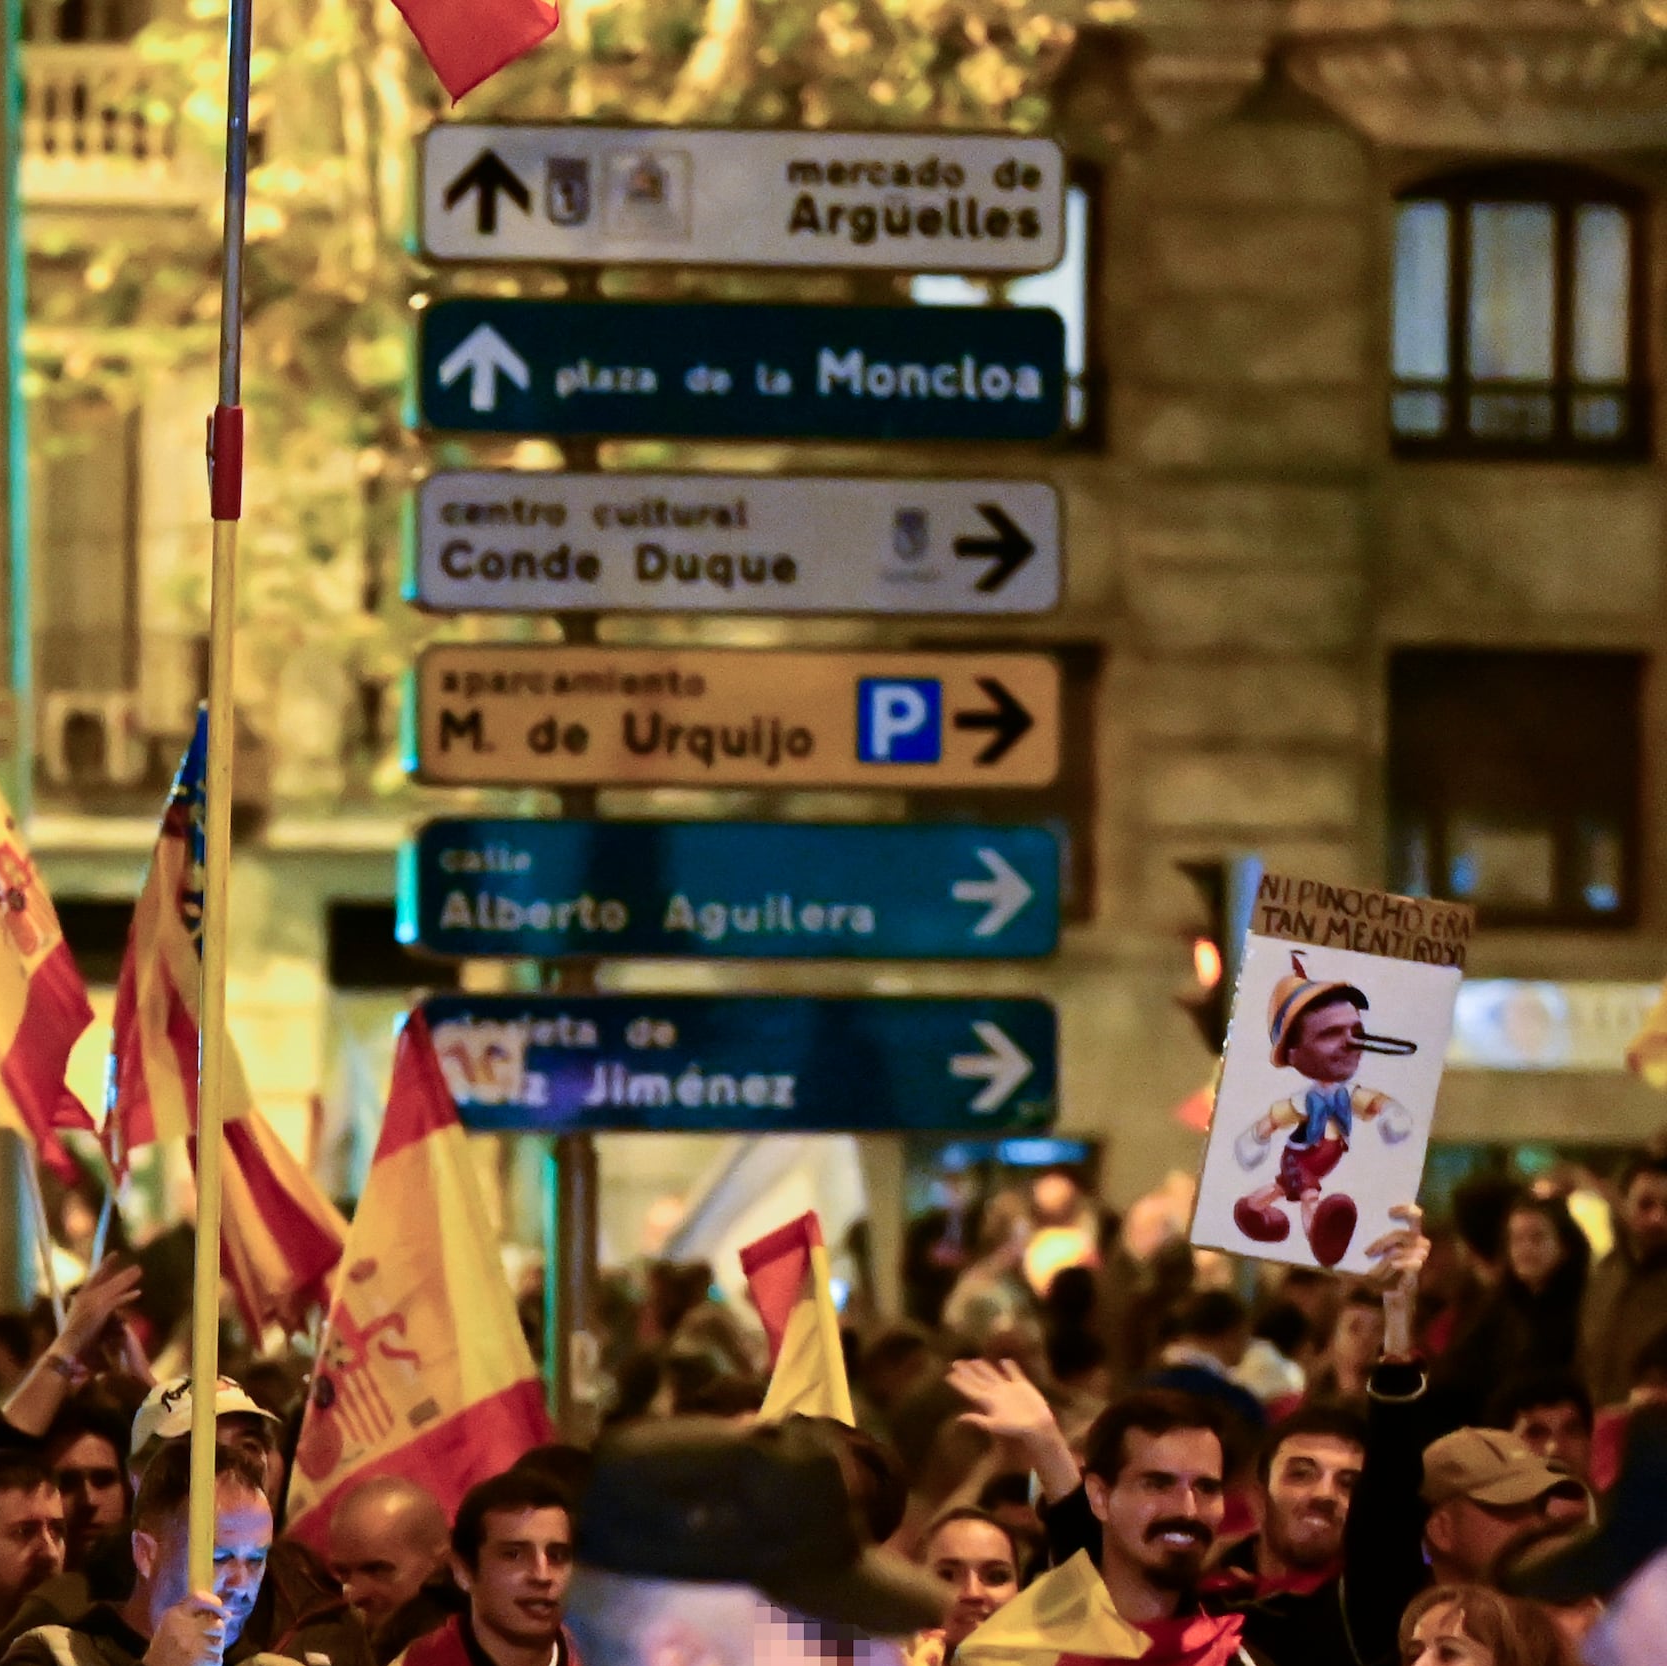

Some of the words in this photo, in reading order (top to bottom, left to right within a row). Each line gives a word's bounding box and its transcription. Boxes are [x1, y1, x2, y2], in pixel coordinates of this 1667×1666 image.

[787, 154, 965, 187] mercado
[992, 157, 1042, 192] de
[788, 192, 1042, 246] Argüelles
[556, 359, 659, 399] plaza
[684, 362, 732, 394] de
[755, 360, 793, 395] la
[816, 347, 1043, 400] Moncloa
[439, 499, 567, 528] centro
[592, 499, 749, 529] cultural
[440, 540, 601, 582] Conde
[635, 542, 798, 592] Duque
[440, 708, 496, 753] M.
[527, 714, 589, 755] de
[623, 709, 815, 767] Urquijo
[869, 683, 927, 760] P
[440, 842, 532, 873] calle
[440, 890, 629, 932] Alberto
[662, 892, 876, 942] Aguilera
[1259, 873, 1291, 905] NI
[1298, 879, 1424, 932] PINOCHO
[1430, 909, 1471, 939] ERA
[1262, 904, 1316, 941] TAN
[625, 1015, 678, 1050] de
[585, 1060, 796, 1108] Jiménez
